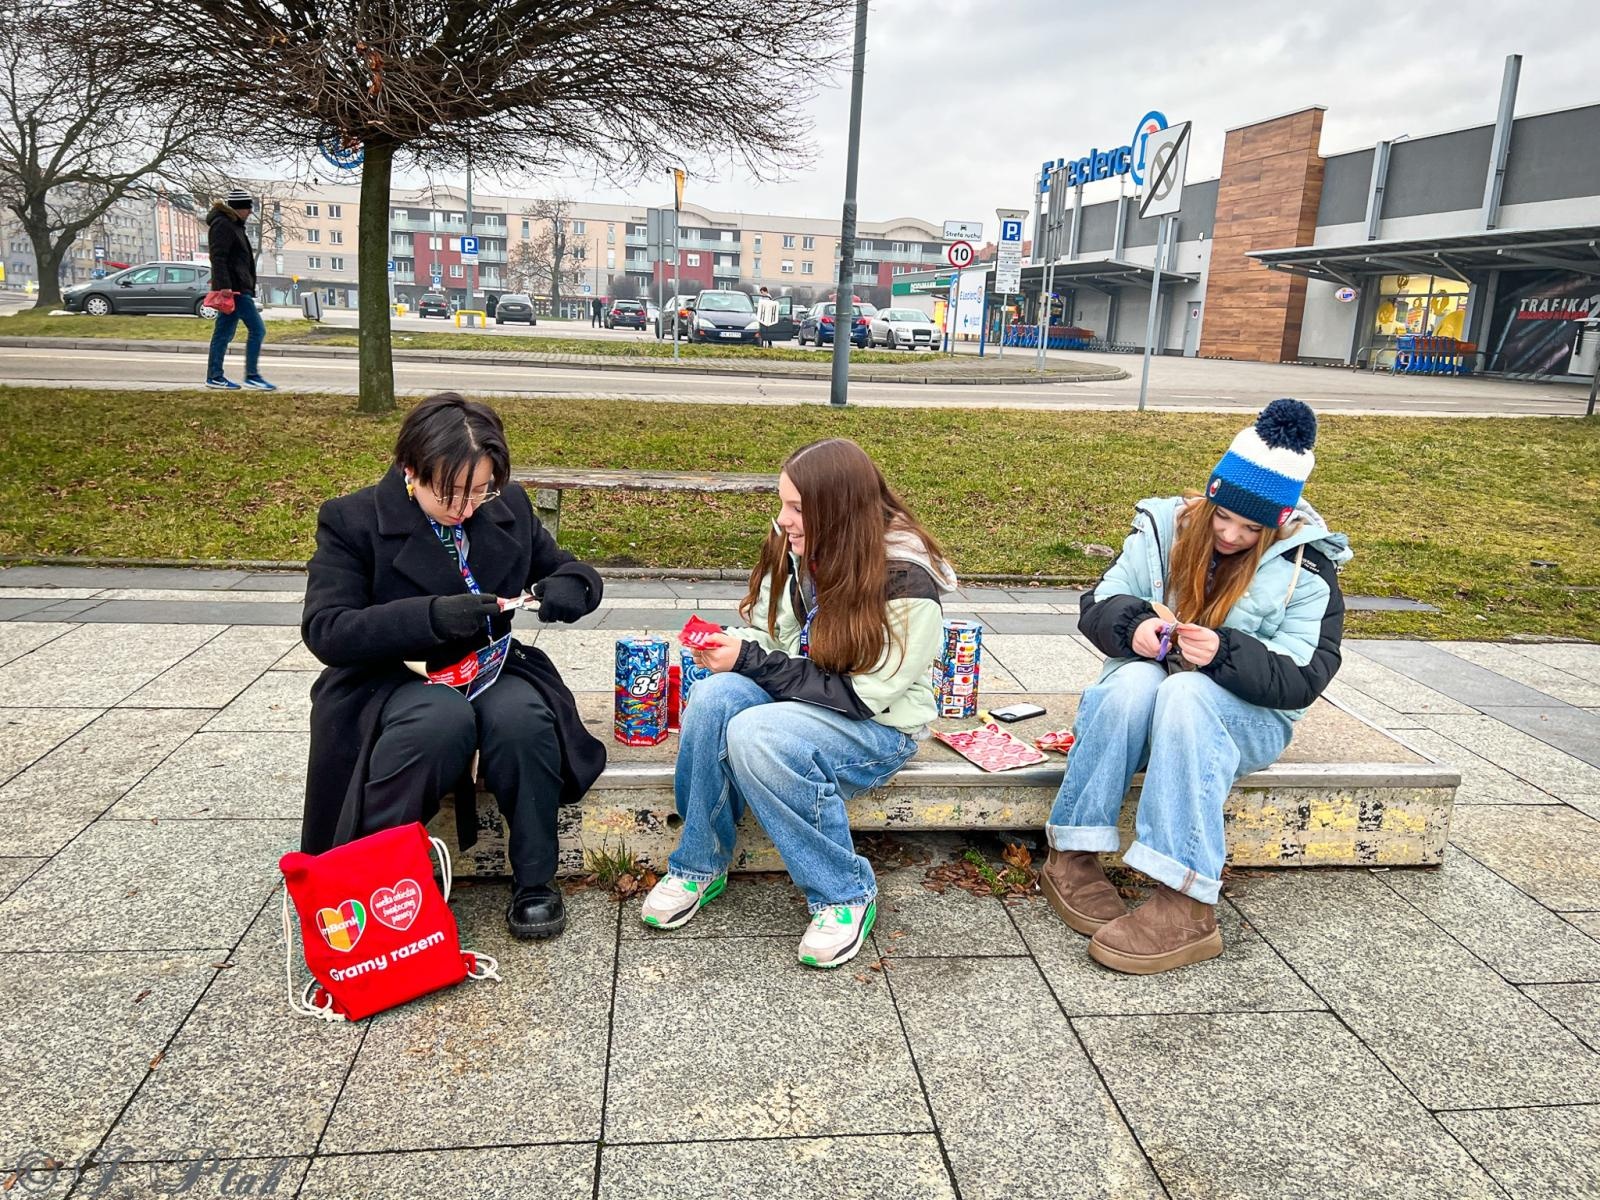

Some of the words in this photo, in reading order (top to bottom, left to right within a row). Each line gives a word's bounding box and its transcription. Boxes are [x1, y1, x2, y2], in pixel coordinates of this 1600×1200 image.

[945, 231, 963, 239] Strefa
[964, 232, 981, 240] ruchu
[953, 247, 969, 261] 10
[1519, 298, 1590, 312] TRAFIKA
[630, 669, 662, 698] 33
[321, 916, 360, 936] mBank
[329, 954, 388, 981] Gramy
[390, 930, 445, 961] razem
